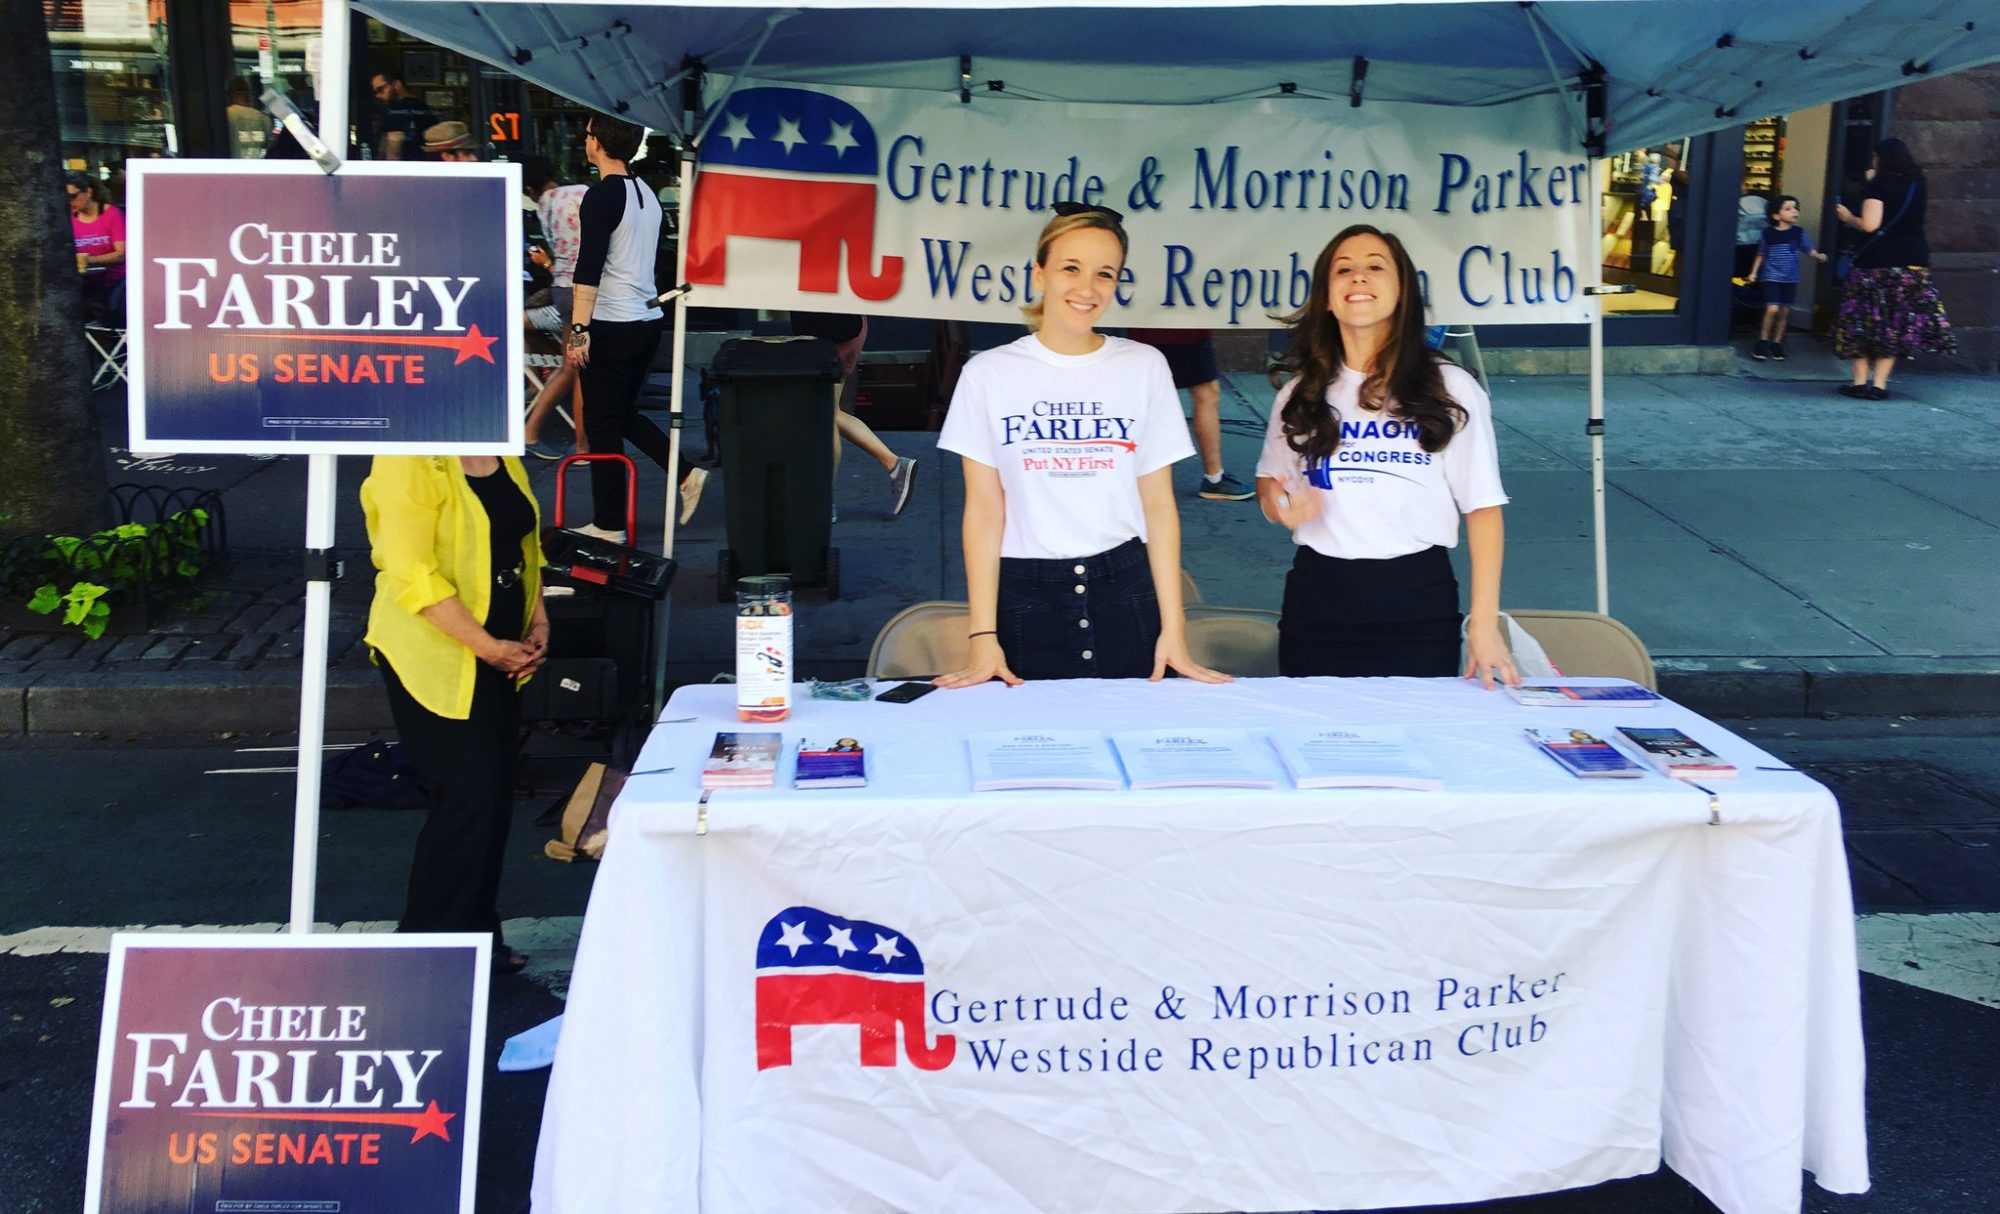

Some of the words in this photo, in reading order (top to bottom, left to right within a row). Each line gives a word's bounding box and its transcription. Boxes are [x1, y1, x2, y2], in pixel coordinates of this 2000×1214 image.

[886, 134, 1104, 210] Gertrude
[1127, 155, 1165, 212] &
[1190, 146, 1408, 212] Morrison
[1433, 149, 1586, 214] Parker
[920, 236, 1135, 306] Weste
[1161, 245, 1429, 324] Repubn
[1458, 245, 1576, 307] Club
[208, 353, 258, 383] US
[273, 353, 426, 384] SENATE
[1340, 420, 1421, 440] NAOM
[1022, 457, 1048, 471] Put
[1052, 456, 1075, 471] NY
[1077, 456, 1115, 470] First
[1339, 450, 1432, 466] CONGRESS
[931, 987, 1130, 1025] Gertrude
[1155, 985, 1187, 1021] &
[1212, 983, 1412, 1020] Morrison
[1434, 971, 1566, 1012] Parker
[967, 1037, 1165, 1074] Westside
[1189, 1031, 1434, 1081] Republican
[1457, 1014, 1548, 1057] Club
[168, 1133, 217, 1165] US
[232, 1133, 380, 1165] SENATE
